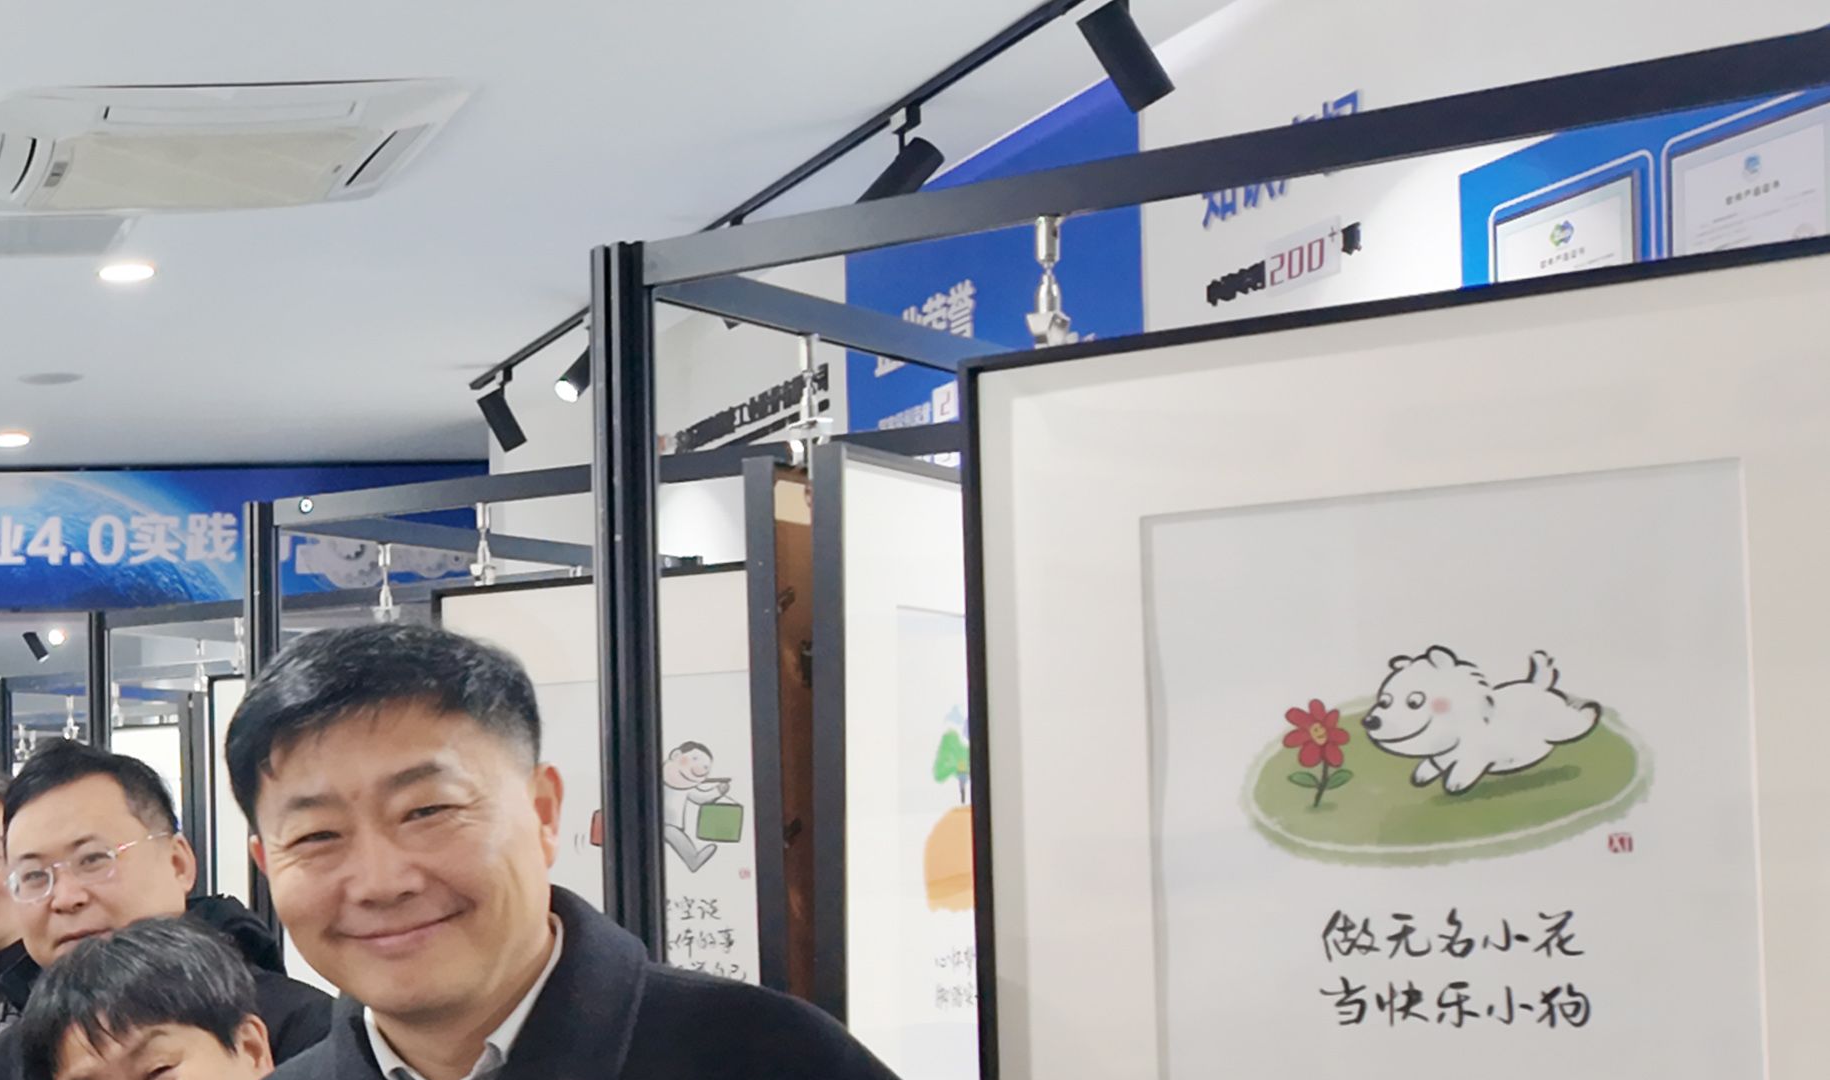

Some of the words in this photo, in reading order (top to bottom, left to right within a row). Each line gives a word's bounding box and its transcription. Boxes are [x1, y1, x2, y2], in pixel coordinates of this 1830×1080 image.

[1321, 907, 1585, 962] 做无名小花
[1319, 976, 1592, 1028] 当快乐小狗
